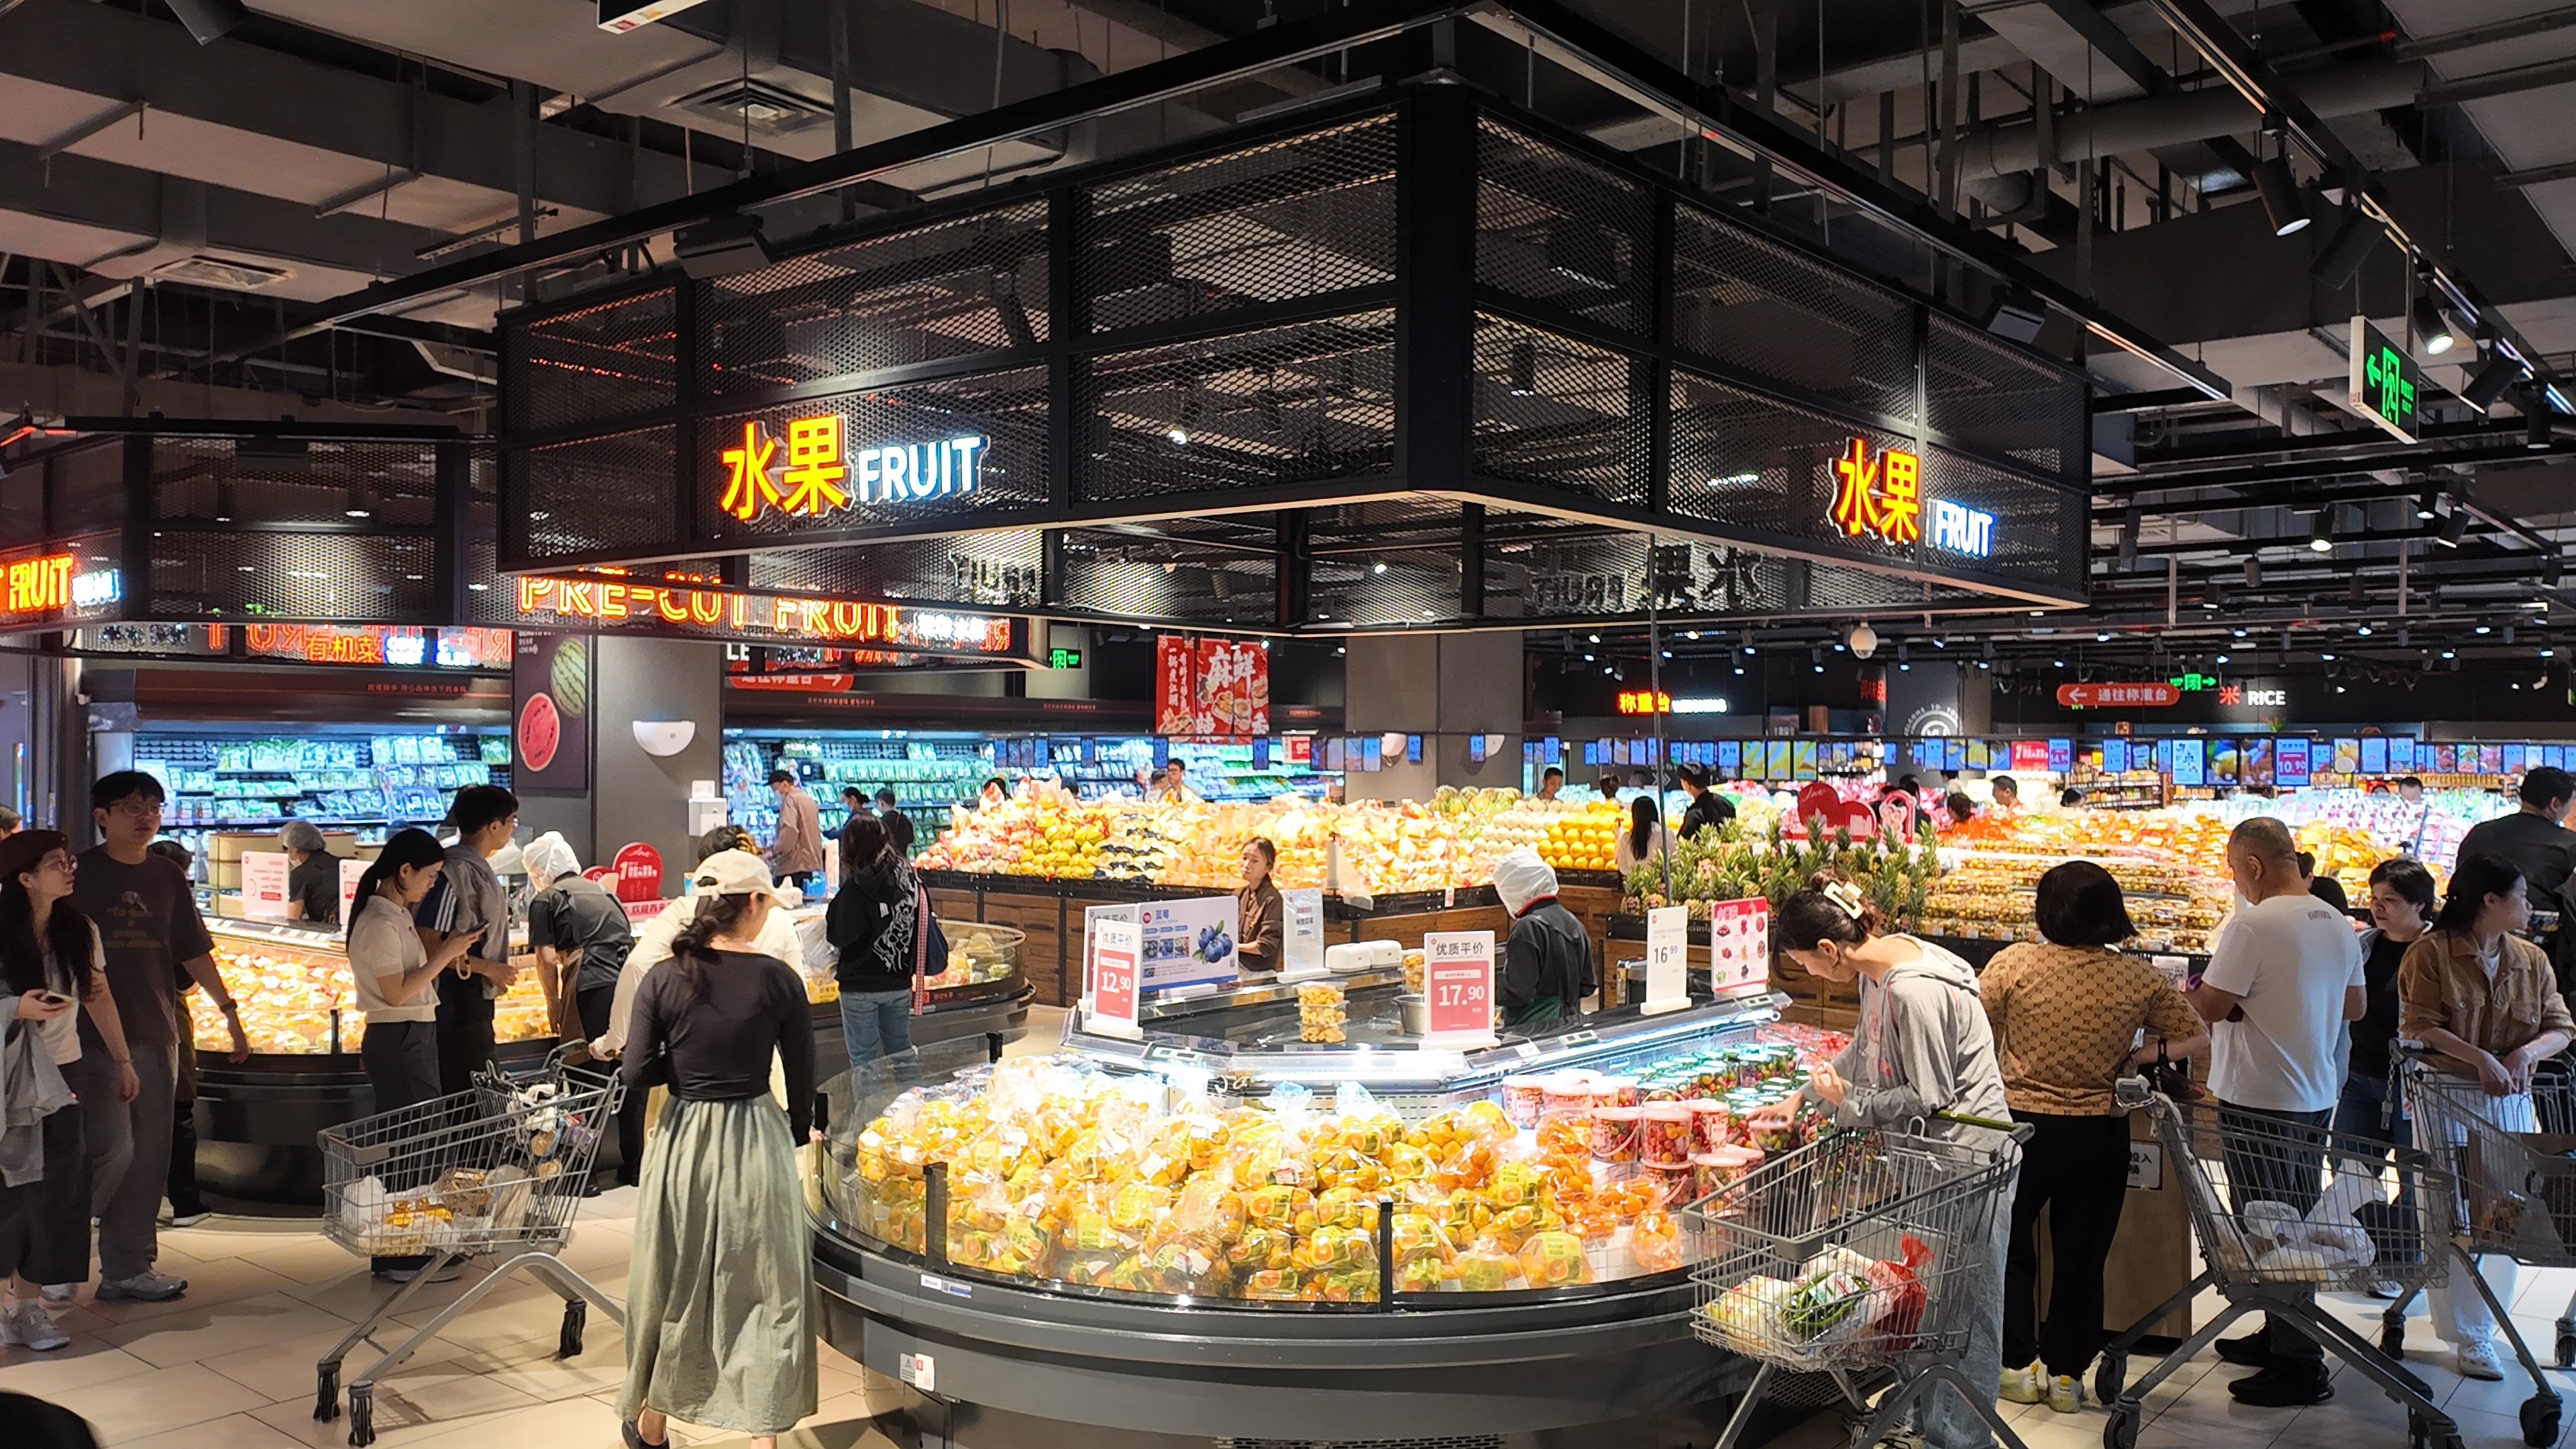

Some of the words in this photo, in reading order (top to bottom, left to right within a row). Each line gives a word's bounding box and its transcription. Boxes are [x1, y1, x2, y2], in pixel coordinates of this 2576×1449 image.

[720, 415, 847, 521] 水果
[857, 436, 983, 502] FRUIT
[1836, 437, 1921, 543] 水果
[1934, 500, 1994, 558] FRUIT
[8, 557, 71, 610] FRUIT
[774, 596, 901, 639] FRUIT
[307, 634, 382, 663] 有机菜
[2098, 688, 2167, 702] 通往称重台
[2219, 685, 2241, 706] 米
[2247, 690, 2287, 706] RICE
[1436, 941, 1484, 956] 优质平价
[1101, 971, 1132, 994] 12.90
[1438, 984, 1485, 1007] 17.90
